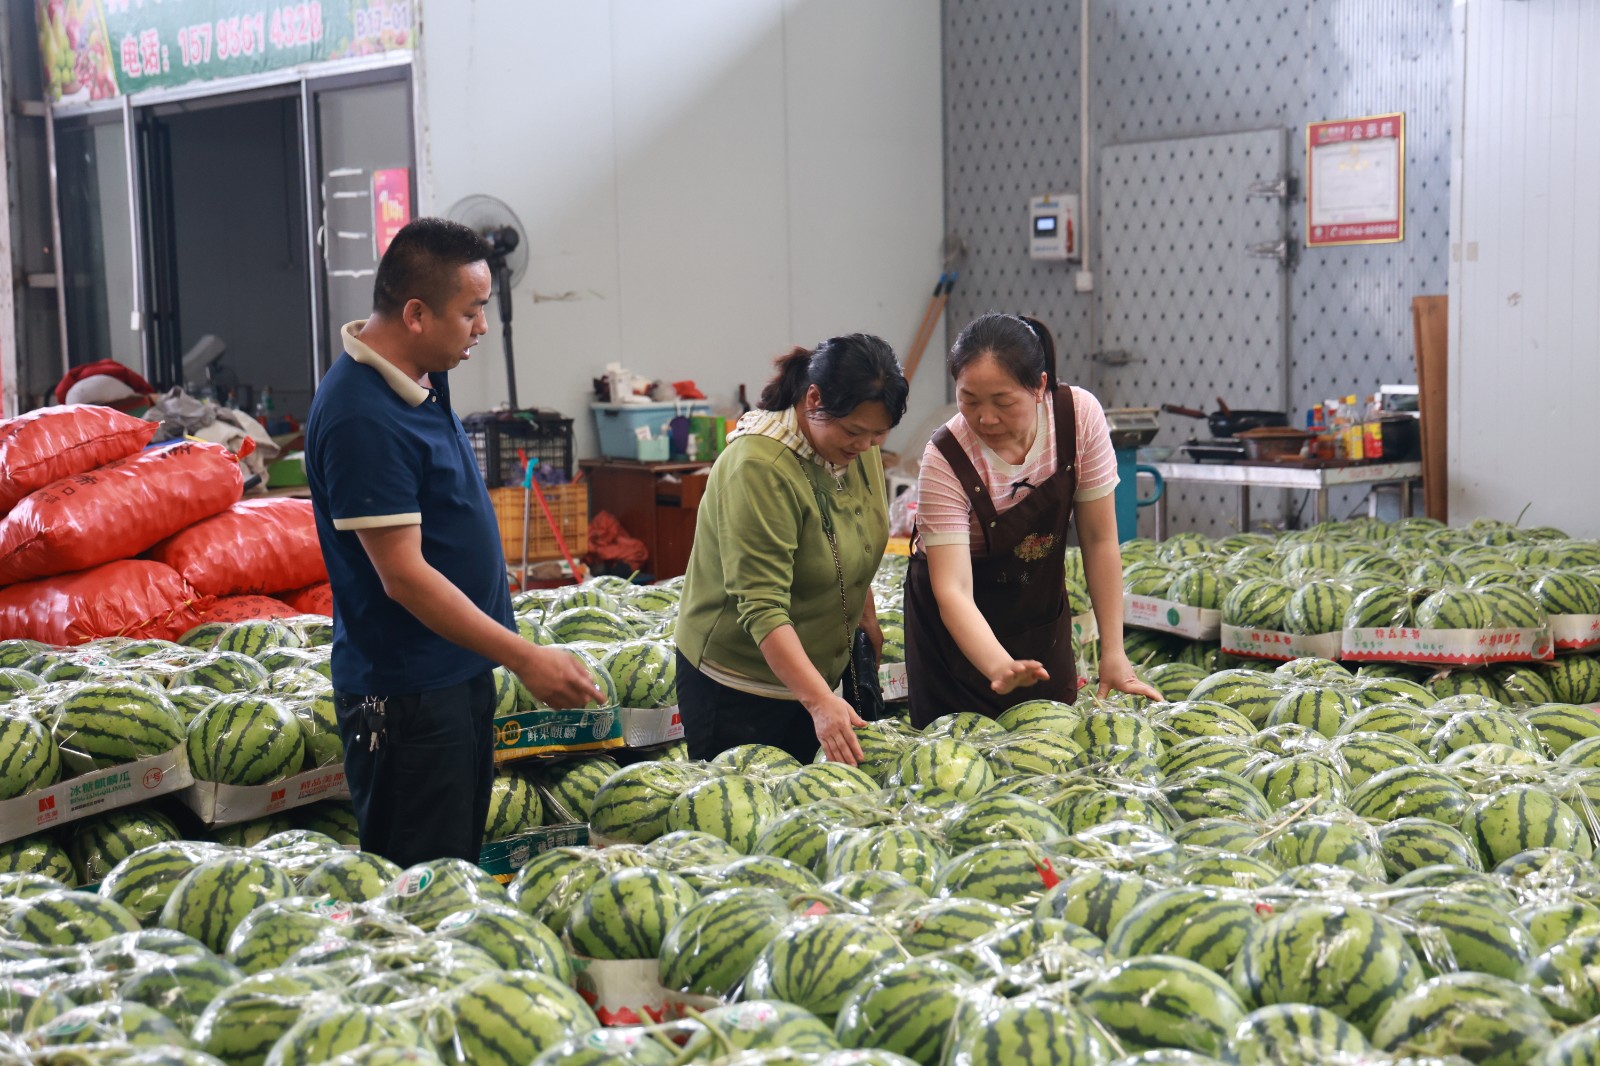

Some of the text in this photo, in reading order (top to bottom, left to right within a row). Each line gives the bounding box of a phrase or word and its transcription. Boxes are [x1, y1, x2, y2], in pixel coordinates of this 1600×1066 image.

[178, 23, 212, 66] 157
[216, 12, 265, 60] 9561
[270, 1, 323, 49] 4328
[70, 771, 130, 797] 冰糖麒麟瓜
